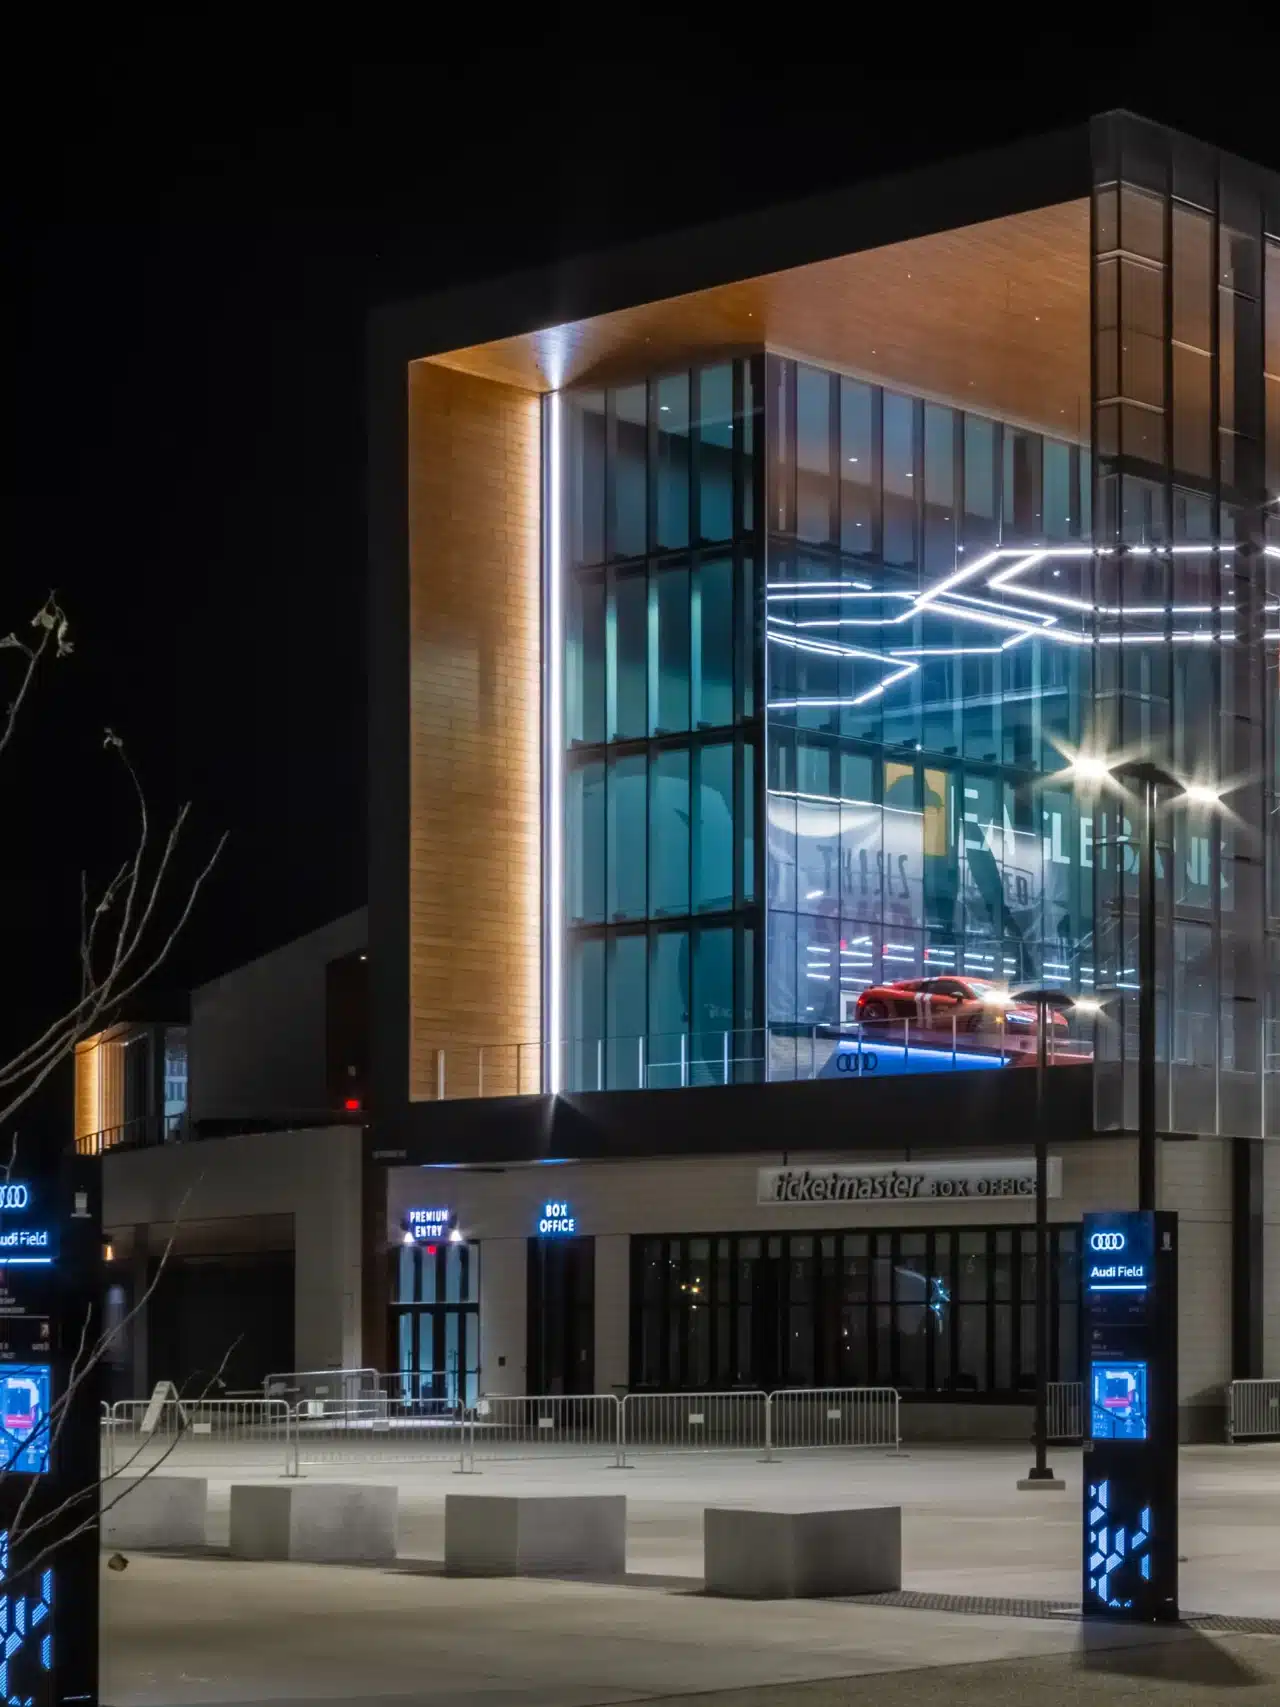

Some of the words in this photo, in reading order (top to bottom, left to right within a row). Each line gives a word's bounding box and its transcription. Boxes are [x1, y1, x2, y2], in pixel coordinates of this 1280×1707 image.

[774, 1171, 924, 1201] ticketmaster
[931, 1179, 968, 1197] BOX
[410, 1209, 448, 1223] PREMIUM
[546, 1204, 567, 1217] BOX
[415, 1225, 442, 1238] ENTRY
[539, 1218, 575, 1233] OFFICE
[0, 1231, 18, 1246] udi
[20, 1231, 47, 1246] Field
[1090, 1266, 1116, 1277] Audi
[1118, 1266, 1143, 1277] Field
